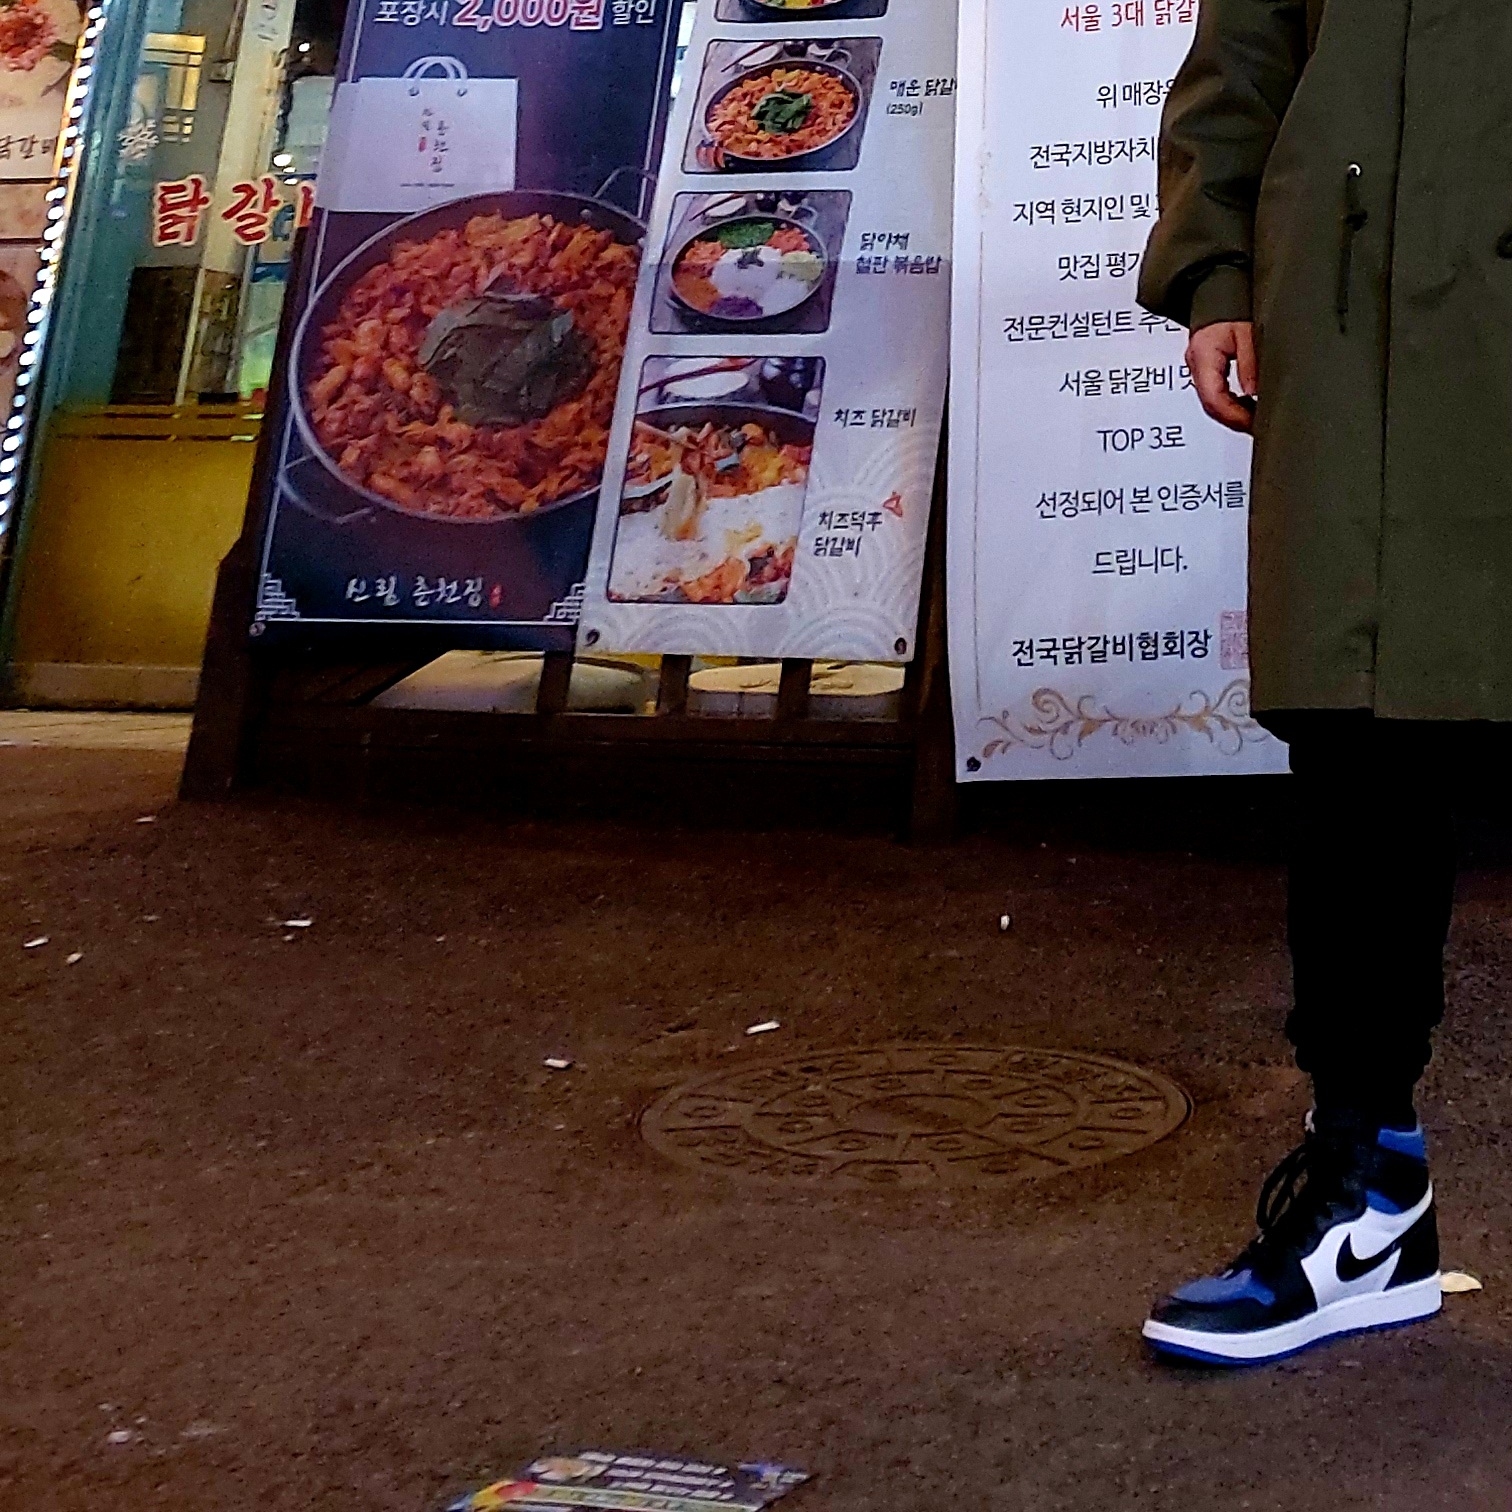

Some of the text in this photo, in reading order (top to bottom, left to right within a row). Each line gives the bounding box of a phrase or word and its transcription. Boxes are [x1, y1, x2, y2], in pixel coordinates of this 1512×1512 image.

[1061, 3, 1102, 34] 서울
[1111, 0, 1146, 29] 3대
[889, 78, 921, 97] 매운
[1096, 84, 1119, 109] 위
[1013, 199, 1056, 226] 지역
[1061, 194, 1125, 225] 현지인
[1129, 193, 1151, 219] 및
[1057, 252, 1102, 281] 맛집
[1002, 309, 1136, 343] 전문컨설턴트
[1059, 368, 1104, 397] 서울
[1109, 365, 1175, 395] 닭갈비
[834, 406, 918, 430] 치즈 닭갈비
[1097, 425, 1187, 454] TOP 3로
[1035, 480, 1248, 520] 선정되어 본 인증서를
[813, 534, 863, 559] 닭갈비
[1091, 544, 1189, 578] 드립니다.
[1011, 629, 1213, 668] 전국닭갈비협회장
